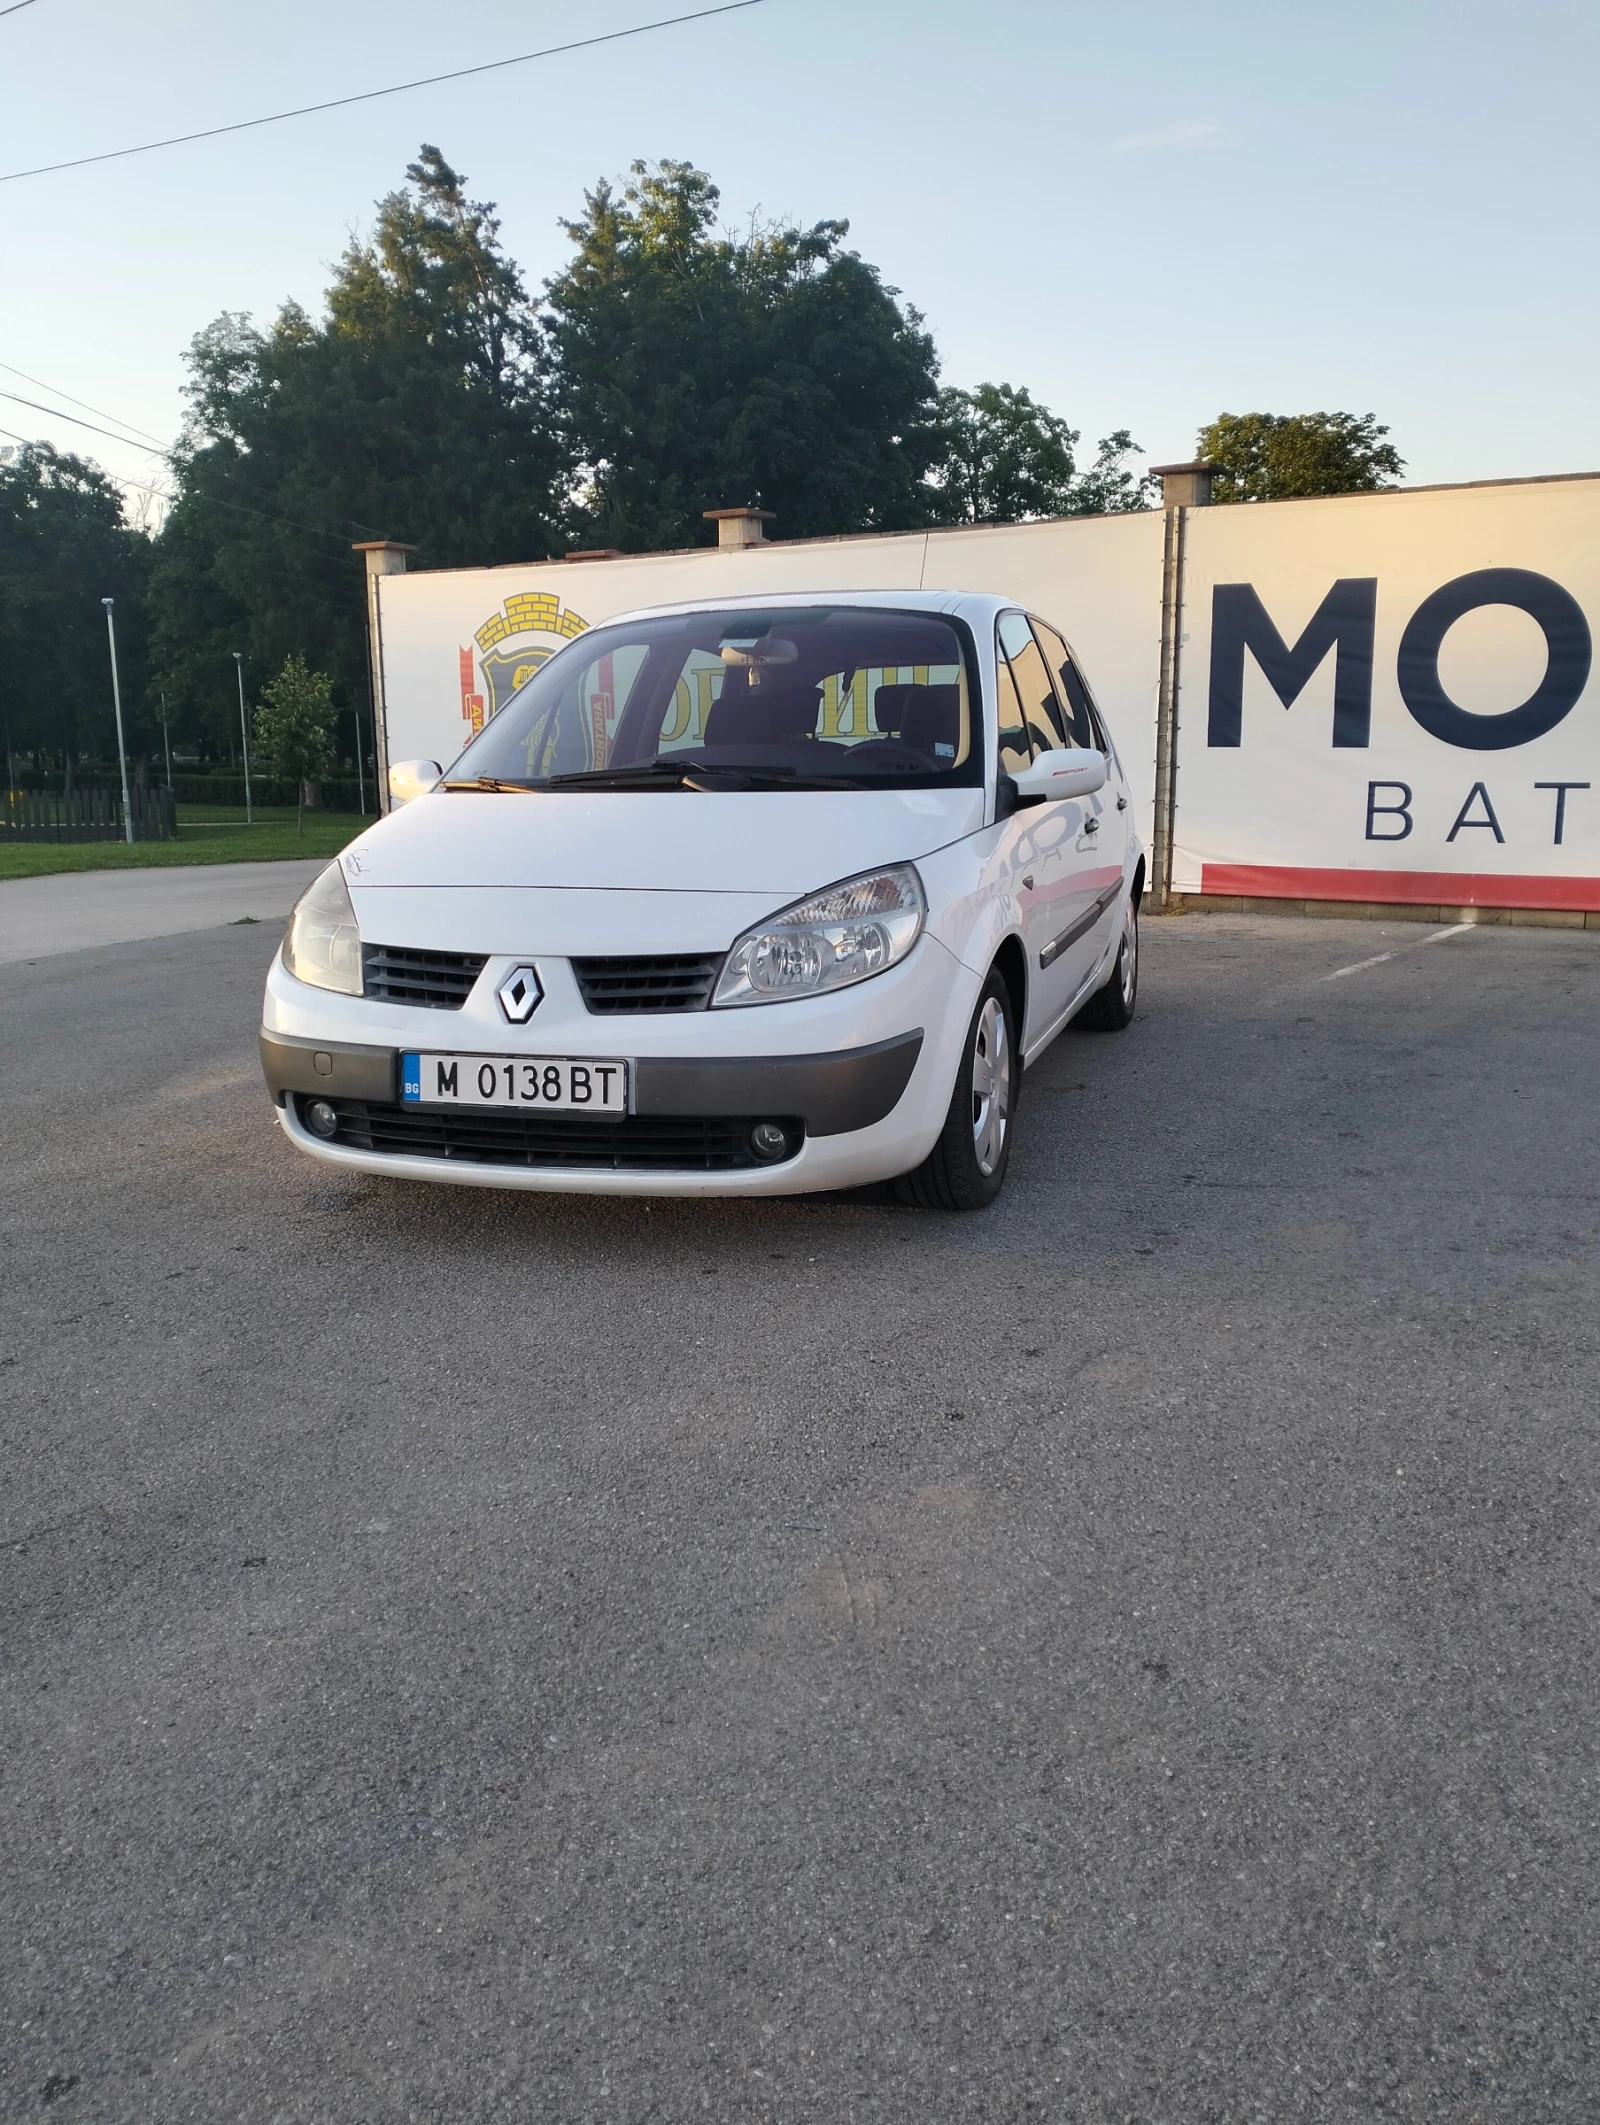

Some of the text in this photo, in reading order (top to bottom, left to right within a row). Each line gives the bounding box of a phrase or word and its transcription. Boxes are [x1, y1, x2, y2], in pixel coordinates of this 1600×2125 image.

[471, 704, 483, 732] ДИ
[405, 1082, 419, 1094] BG
[437, 1061, 458, 1097] M
